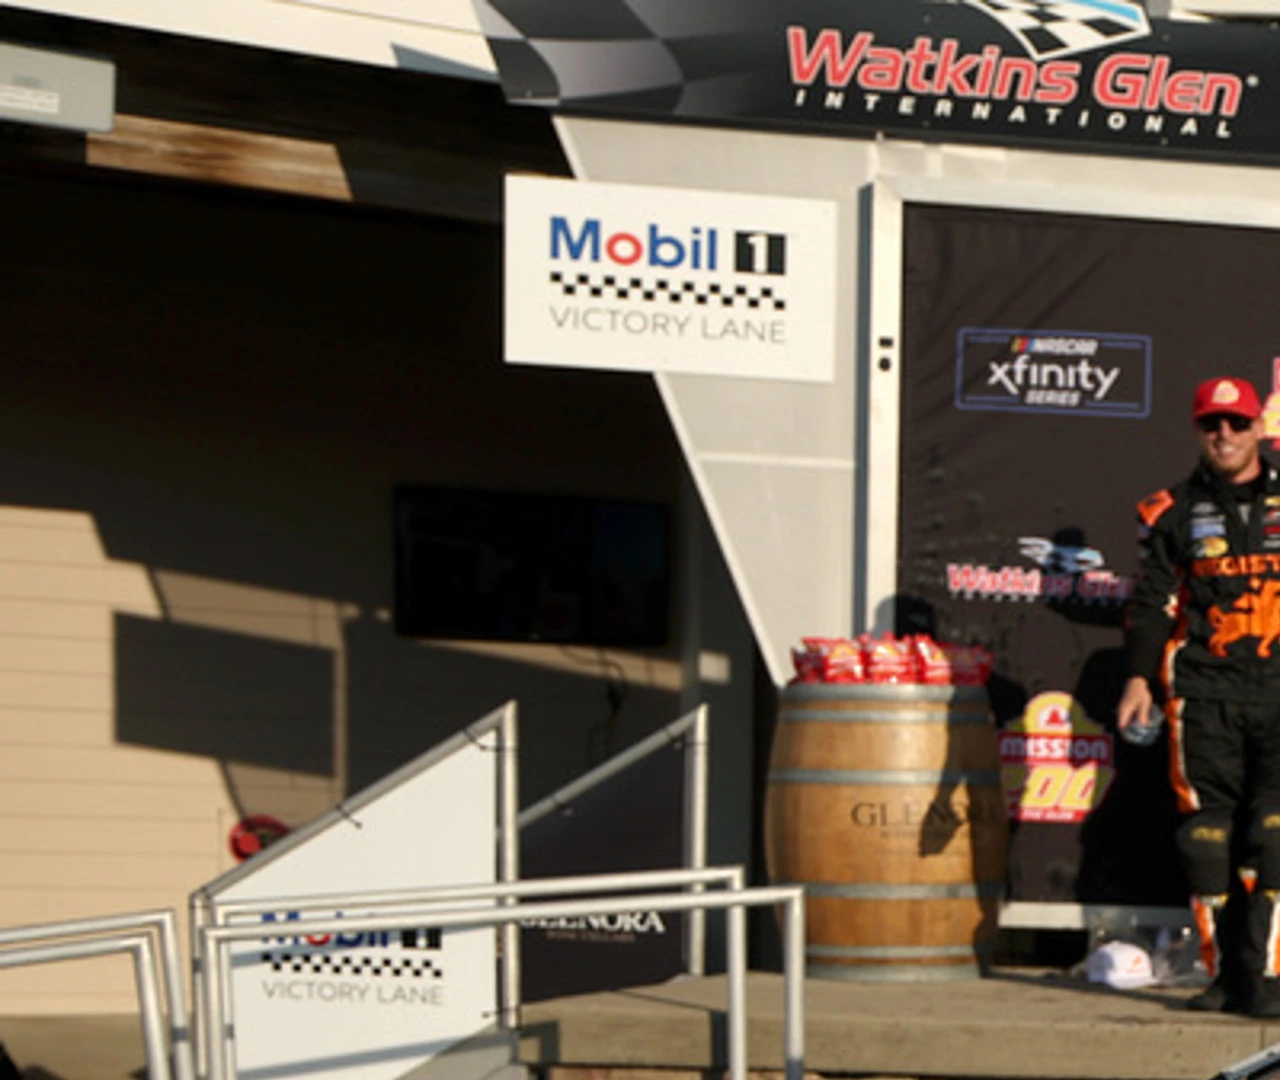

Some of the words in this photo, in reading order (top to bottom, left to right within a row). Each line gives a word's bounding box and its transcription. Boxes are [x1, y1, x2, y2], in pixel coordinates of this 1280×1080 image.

[787, 25, 1081, 103] Watkins
[1094, 52, 1244, 117] Glen
[794, 89, 1234, 139] INTERNATIONAL
[549, 215, 718, 272] Mobil
[741, 231, 774, 275] 1
[548, 305, 692, 338] VICTORY
[701, 315, 787, 344] LANE
[987, 353, 1120, 399] xfinity
[262, 980, 371, 1002] VICTORY
[377, 983, 443, 1006] LANE
